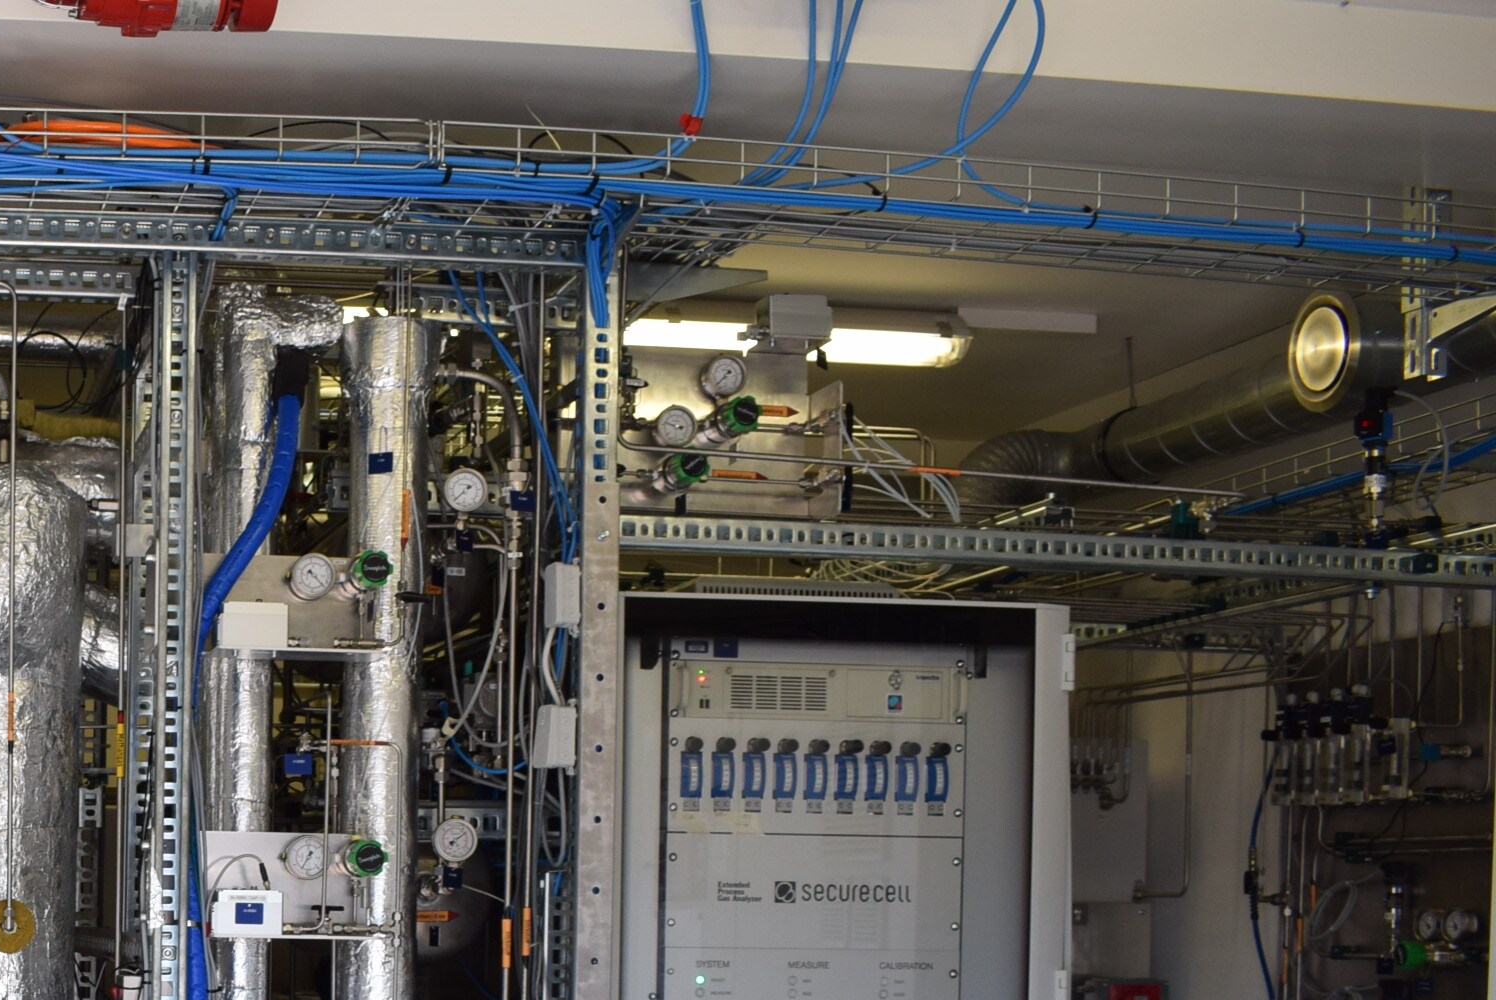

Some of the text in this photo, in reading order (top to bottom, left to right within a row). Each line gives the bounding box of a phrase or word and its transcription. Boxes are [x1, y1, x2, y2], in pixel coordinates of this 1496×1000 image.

[801, 883, 912, 903] securecell
[732, 895, 762, 904] Analyzer
[788, 961, 830, 969] MEASURE
[879, 962, 934, 970] CALIBRATION
